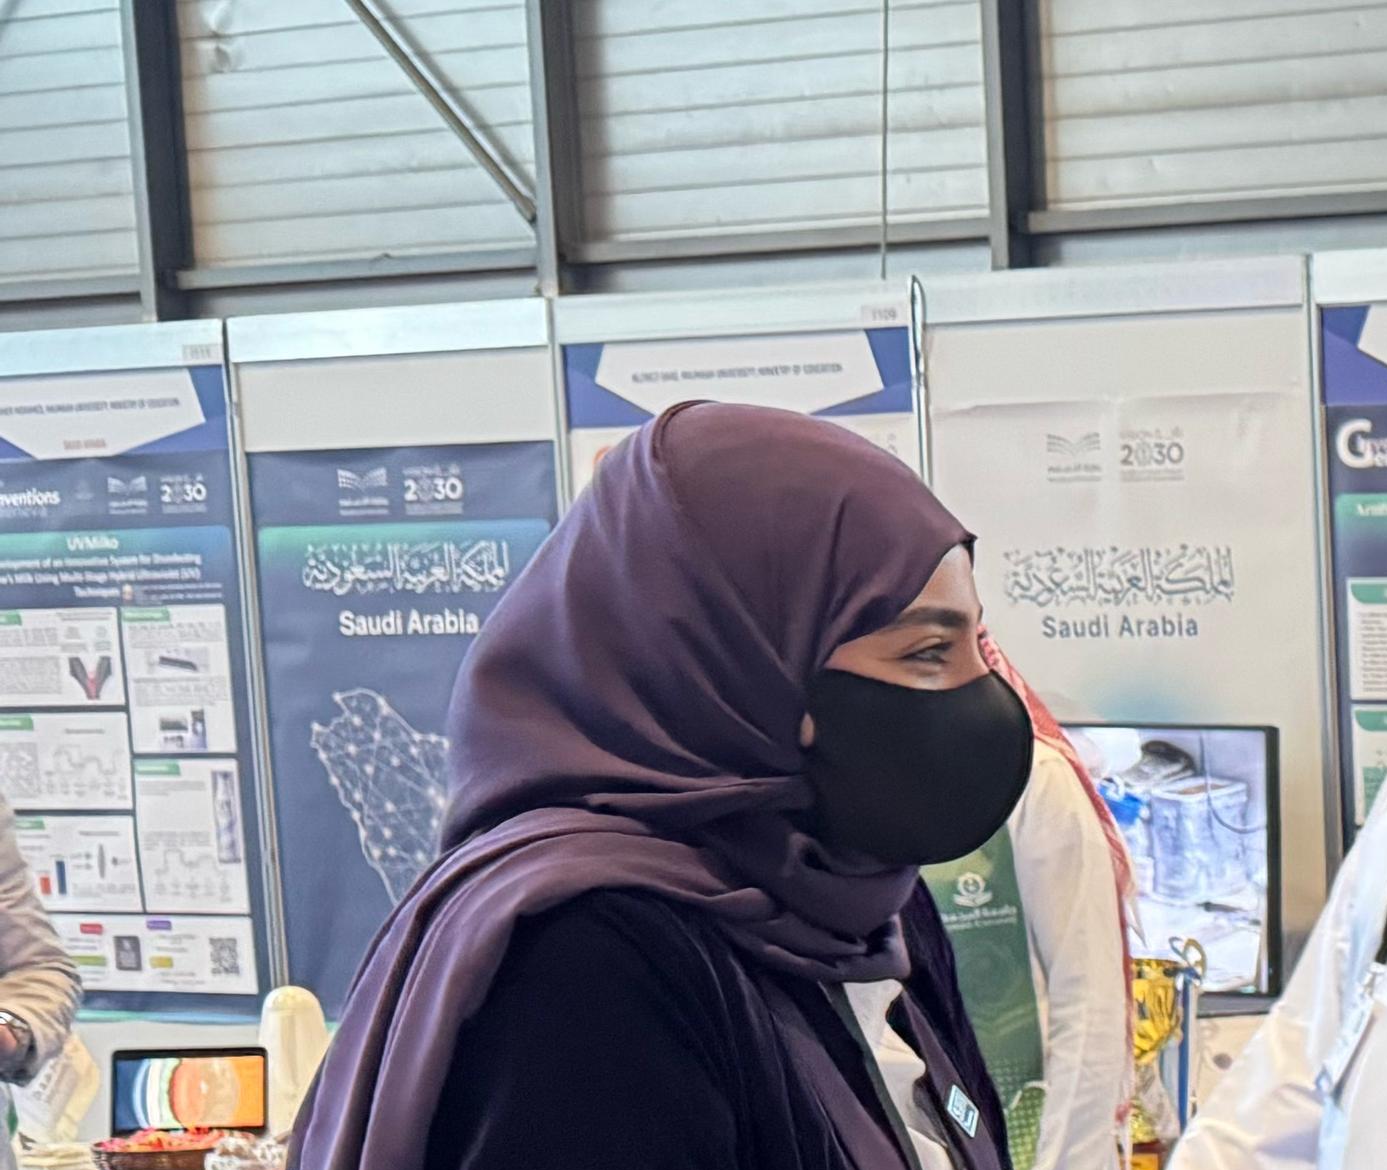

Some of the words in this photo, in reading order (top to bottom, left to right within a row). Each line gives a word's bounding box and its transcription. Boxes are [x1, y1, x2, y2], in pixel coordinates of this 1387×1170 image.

[338, 609, 403, 636] Saudi
[407, 607, 480, 634] Arabia
[1041, 614, 1110, 639] Saudi
[1118, 613, 1199, 638] Arabia
